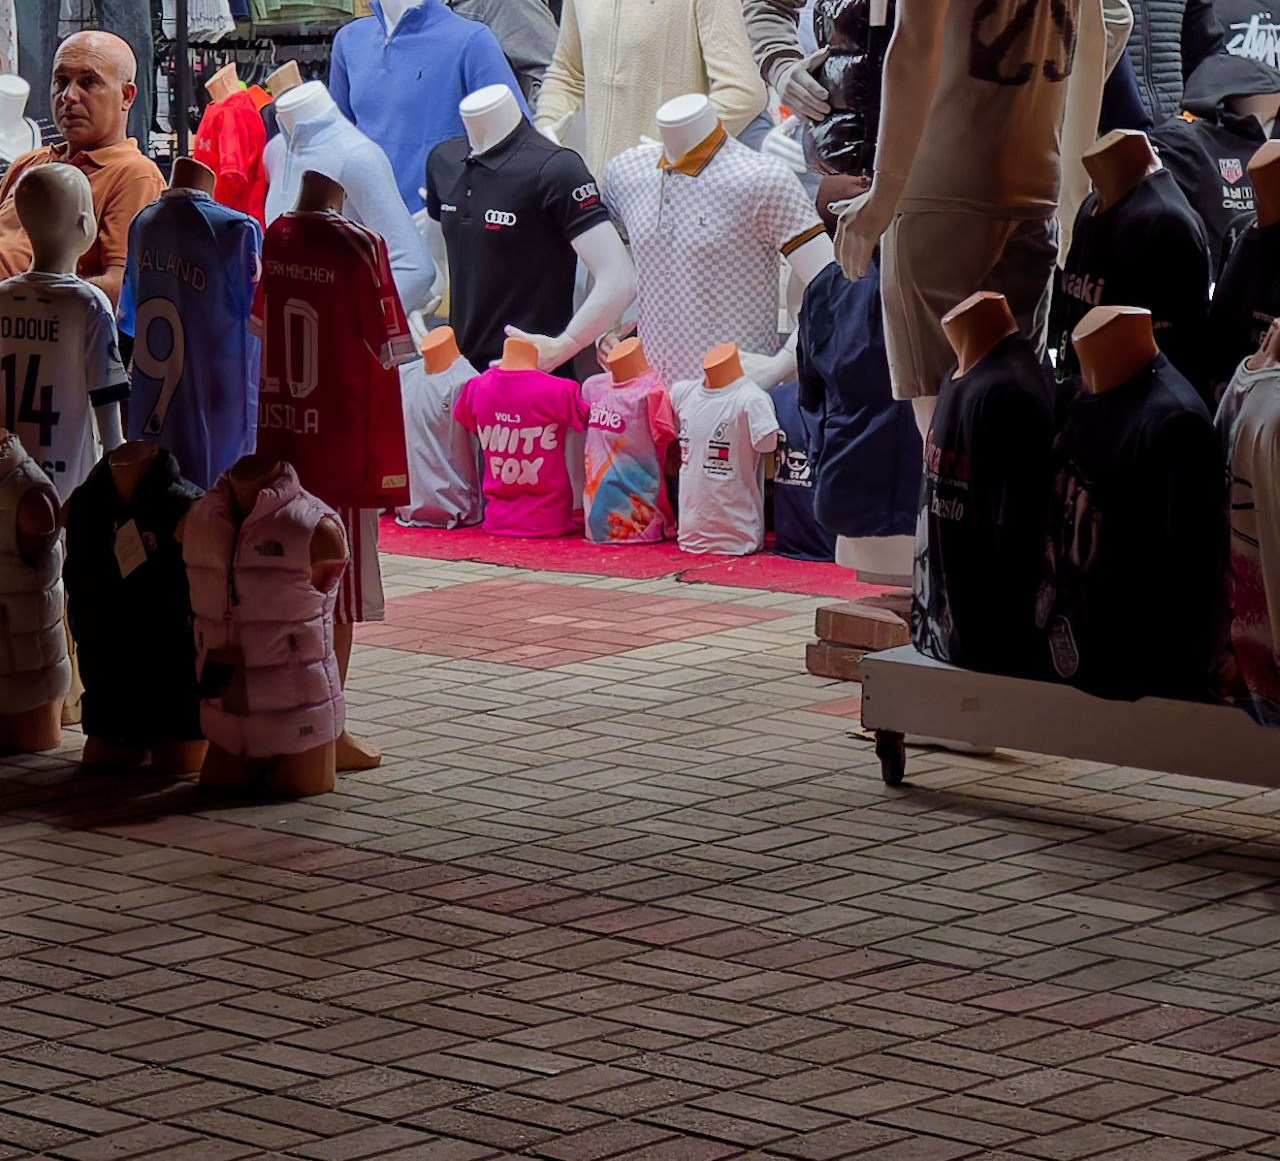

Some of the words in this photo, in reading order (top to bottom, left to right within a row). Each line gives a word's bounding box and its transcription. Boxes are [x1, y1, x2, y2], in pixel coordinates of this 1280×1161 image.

[1, 315, 60, 343] D.DOUÉ
[133, 295, 186, 436] 9
[1, 353, 61, 447] 14
[494, 411, 521, 424] VOL.3
[489, 456, 545, 486] FOX
